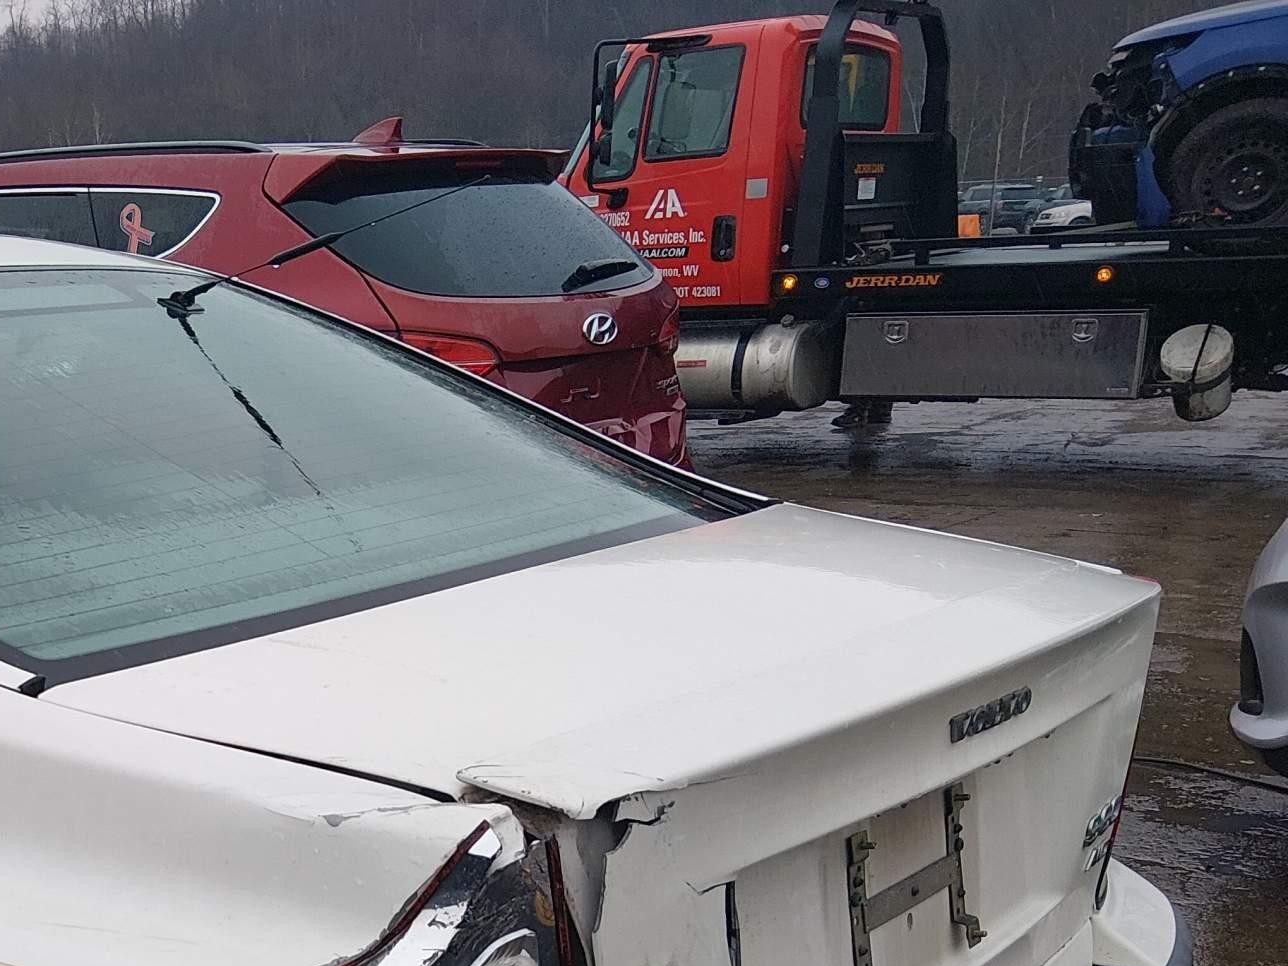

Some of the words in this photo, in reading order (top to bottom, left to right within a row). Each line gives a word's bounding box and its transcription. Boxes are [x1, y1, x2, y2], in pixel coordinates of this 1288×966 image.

[642, 229, 688, 246] Services,
[689, 228, 706, 243] Inc.
[682, 265, 699, 277] WV
